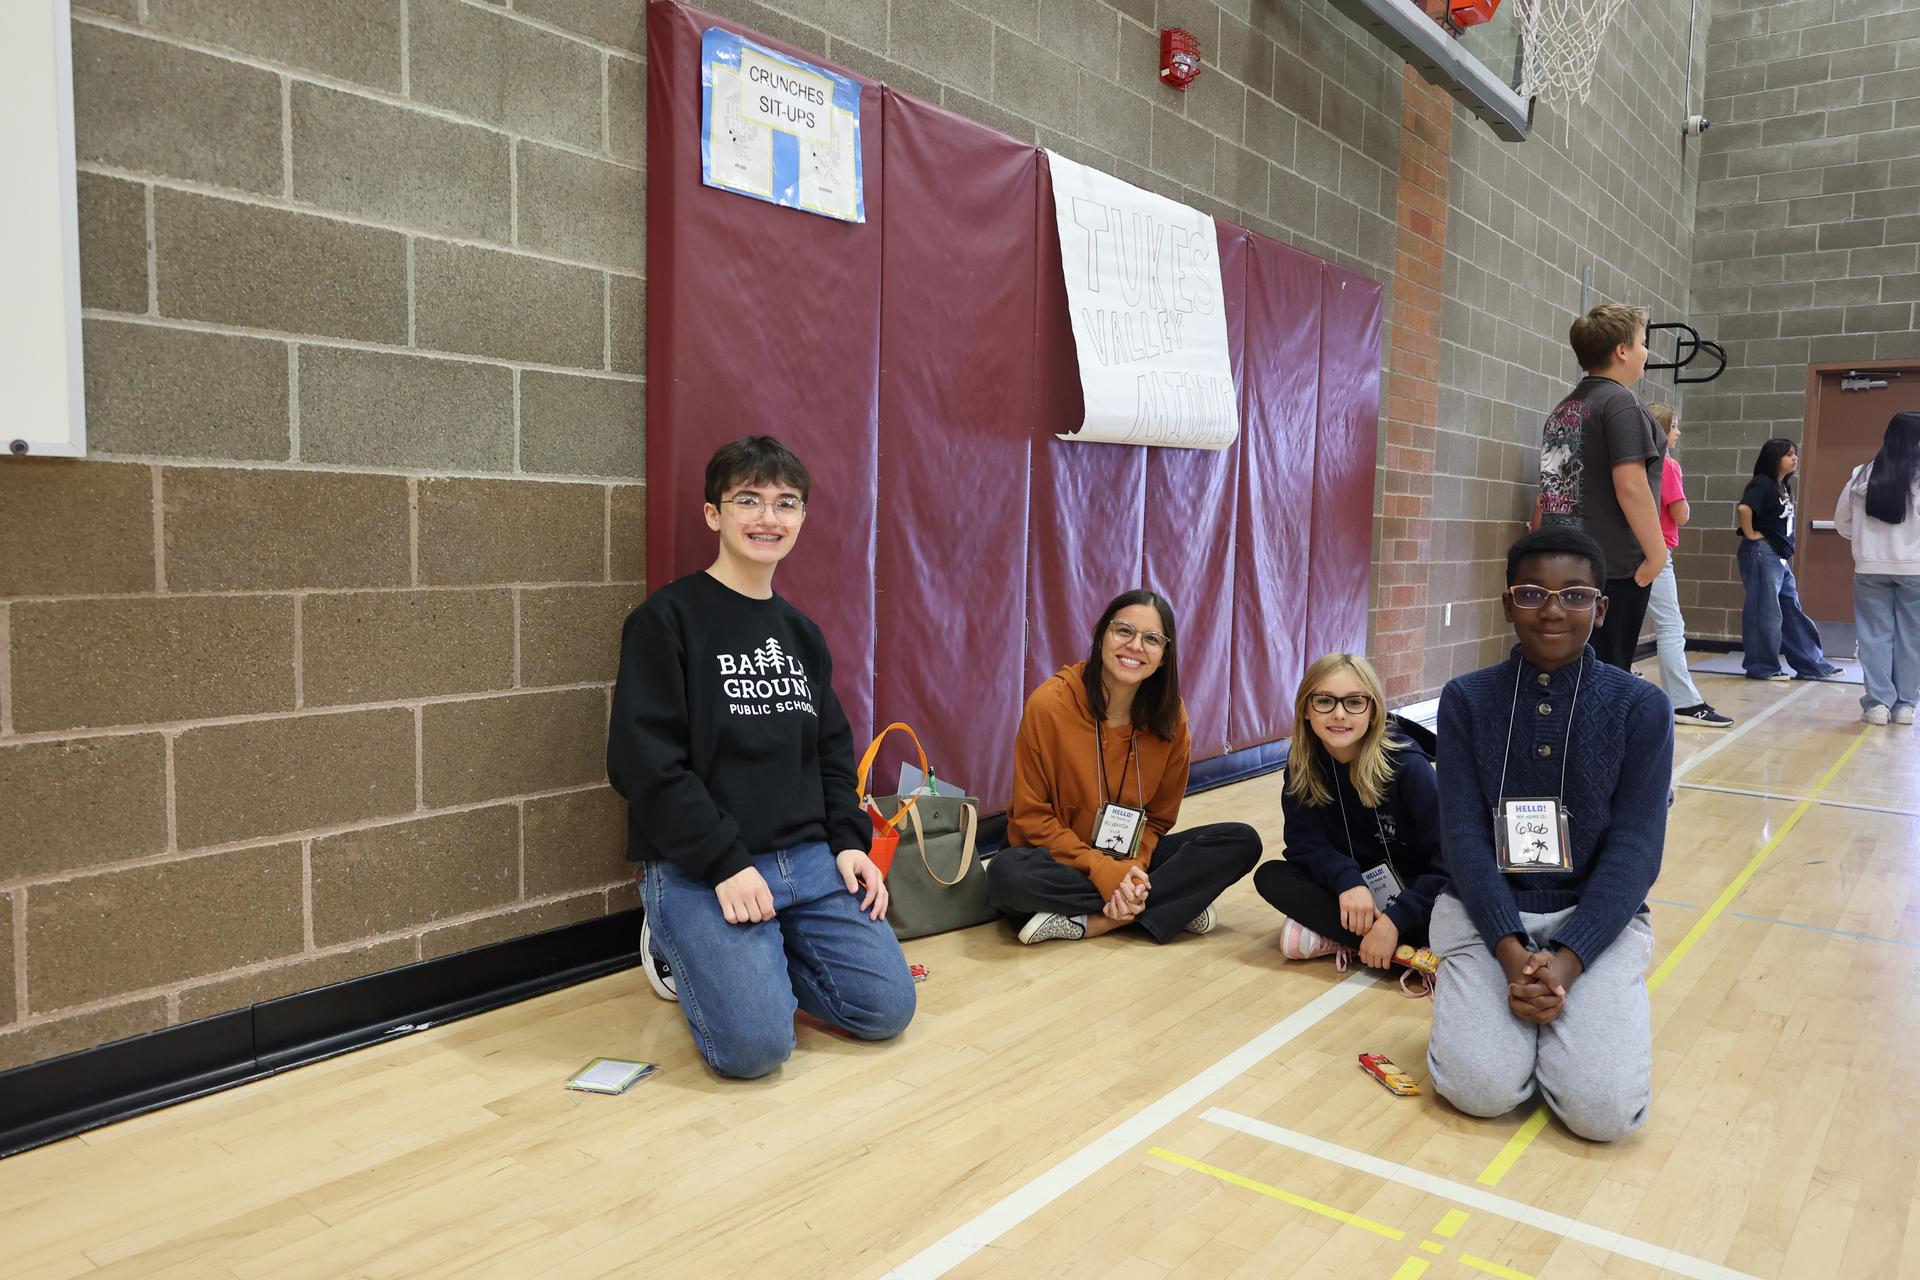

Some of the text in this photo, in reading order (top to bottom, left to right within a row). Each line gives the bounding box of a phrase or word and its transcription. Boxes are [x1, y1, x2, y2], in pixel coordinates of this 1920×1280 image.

[749, 65, 825, 106] CRUNCHES
[759, 95, 815, 129] SIT-UPS
[1071, 196, 1216, 316] TUKES
[1081, 307, 1184, 367] VALLEY
[1124, 370, 1236, 444] MIDDLE
[729, 703, 772, 716] PUBLIC
[1111, 808, 1134, 818] HELLO!
[1515, 804, 1547, 812] HELLO!
[1365, 868, 1385, 880] HELLO!
